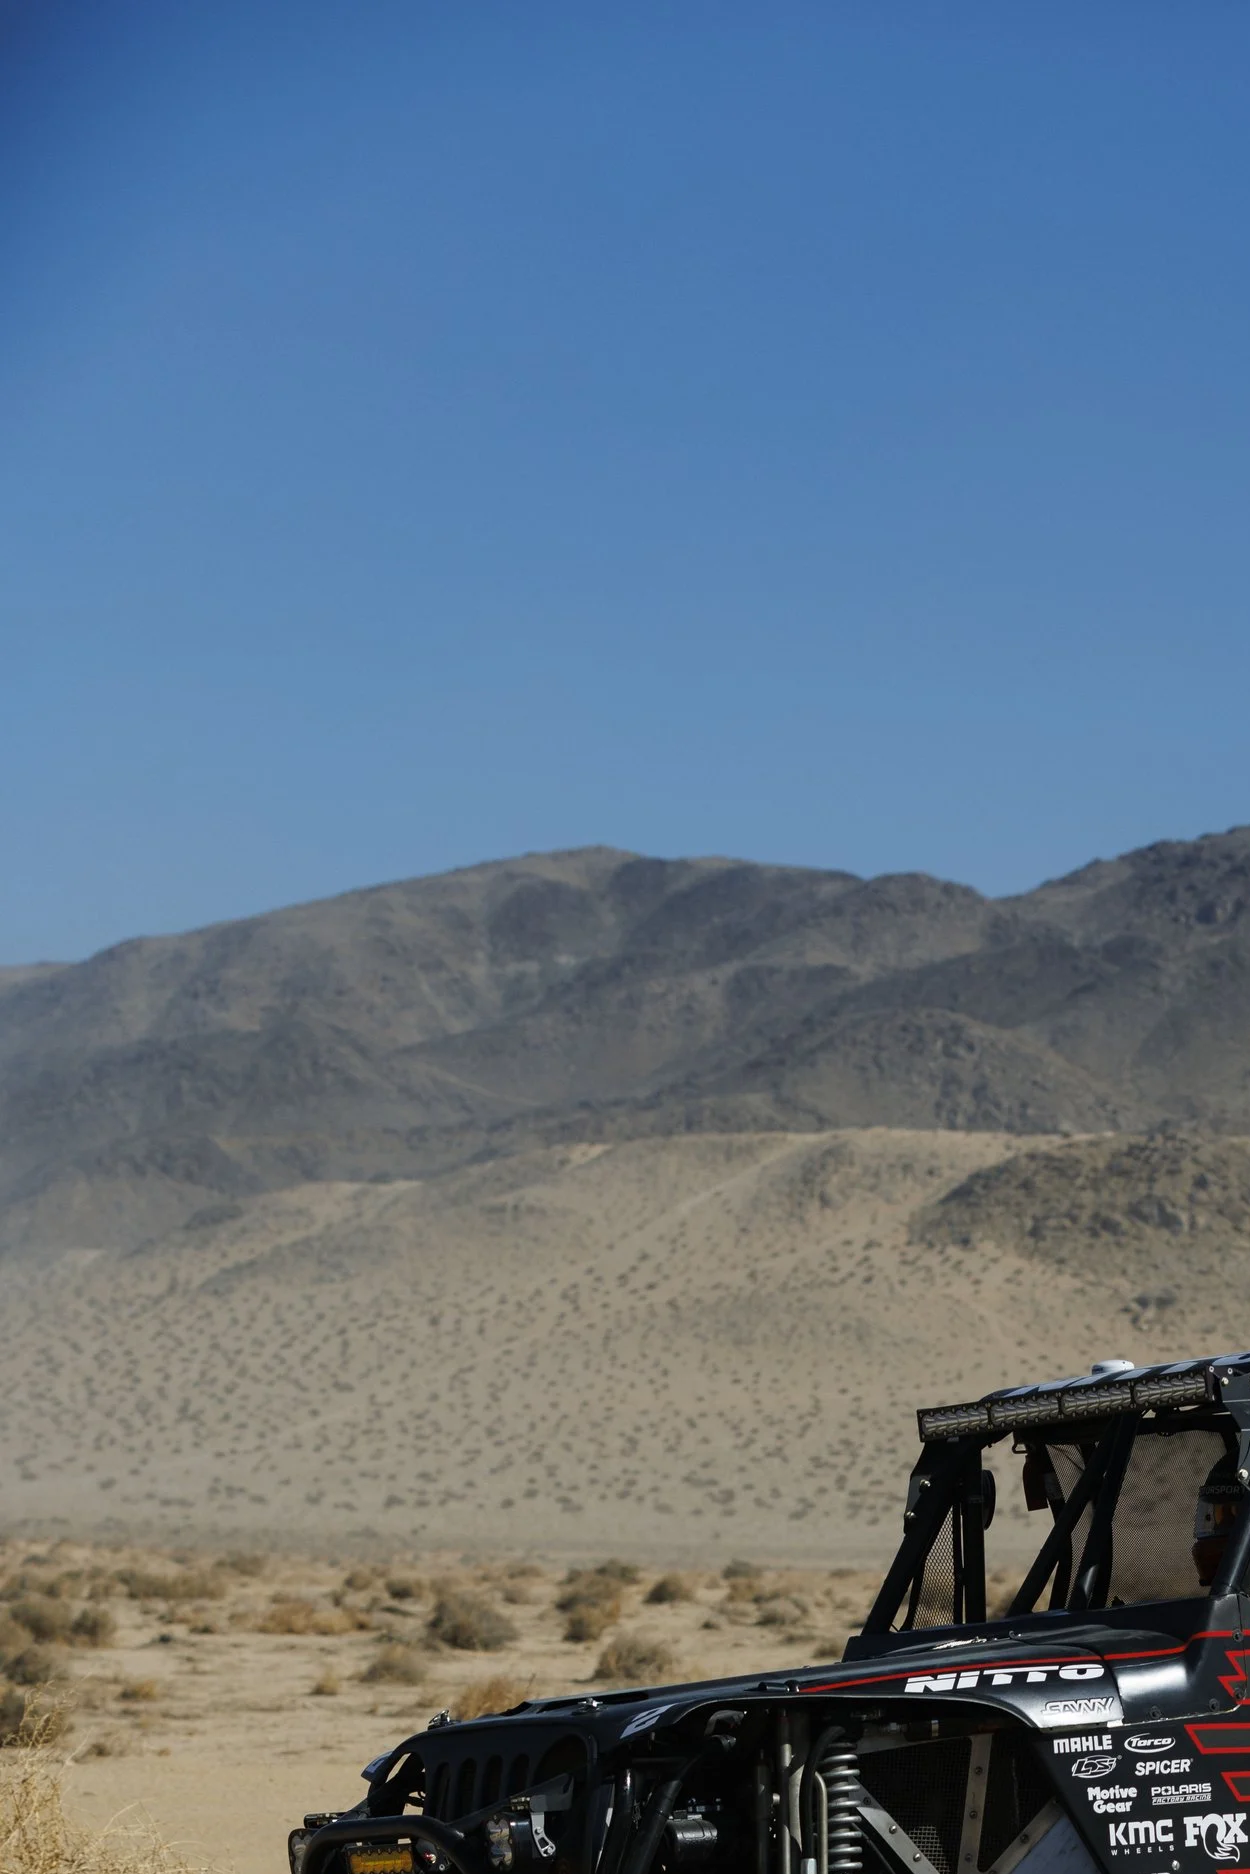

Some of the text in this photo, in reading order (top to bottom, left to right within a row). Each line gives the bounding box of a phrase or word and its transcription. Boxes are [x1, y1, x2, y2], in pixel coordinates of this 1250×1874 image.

[904, 1663, 1105, 1694] NITTO
[1053, 1735, 1113, 1754] MAHLE
[1129, 1735, 1173, 1748] Torco
[1134, 1758, 1191, 1776] SPICER
[1087, 1785, 1138, 1801] Motive
[1151, 1783, 1212, 1797] POLARIS
[1152, 1793, 1212, 1804] FACTORY RACING
[1093, 1800, 1133, 1814] Gear
[1109, 1819, 1174, 1846] KMC
[1183, 1813, 1249, 1861] FOX
[1111, 1844, 1175, 1856] WHEELS
